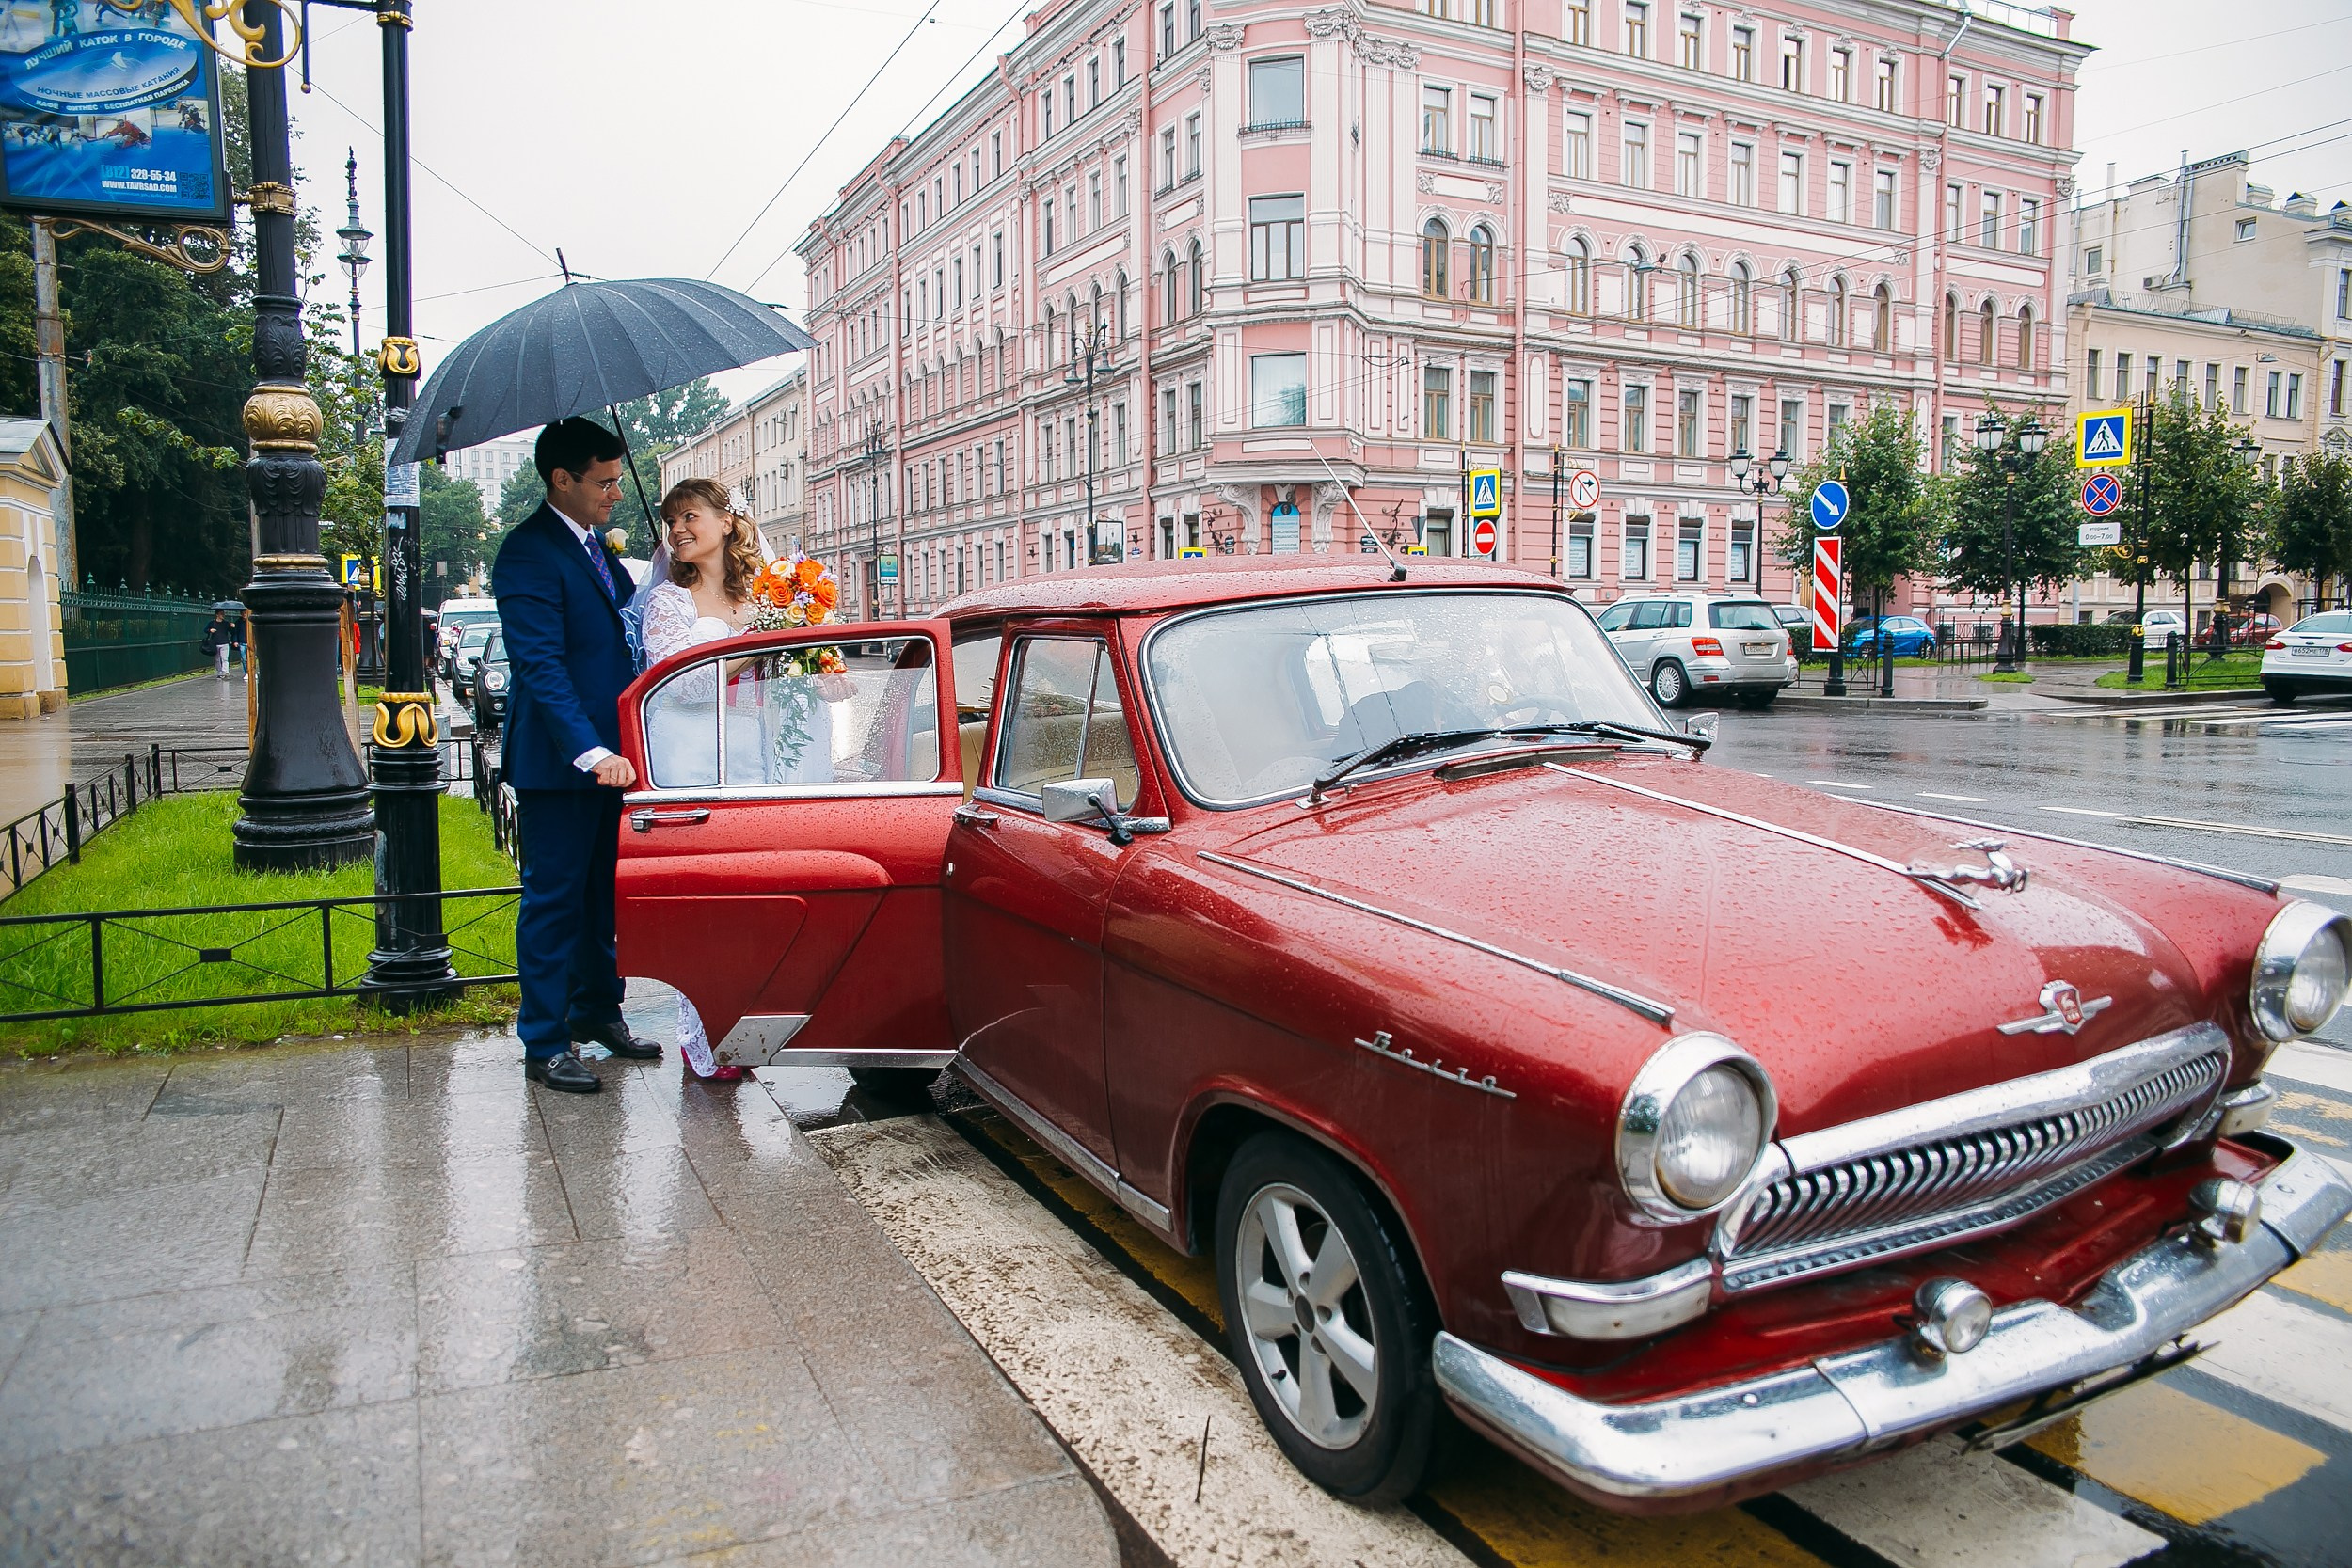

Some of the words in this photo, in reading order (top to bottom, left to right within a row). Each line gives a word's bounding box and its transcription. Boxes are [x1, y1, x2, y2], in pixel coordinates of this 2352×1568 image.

[24, 40, 73, 70] ЛУЧШИЙ
[79, 34, 119, 49] КАТОК
[124, 33, 132, 42] В
[138, 32, 187, 50] ГОРОДЕ
[36, 99, 59, 110] КАФЕ
[104, 93, 154, 110] БЕСПЛАТНАЯ
[154, 79, 190, 99] ПАРКОВКА
[37, 86, 84, 99] НОЧНЫЕ
[86, 85, 139, 99] МАССОВЫЕ
[142, 66, 182, 88] КАТАНИЯ
